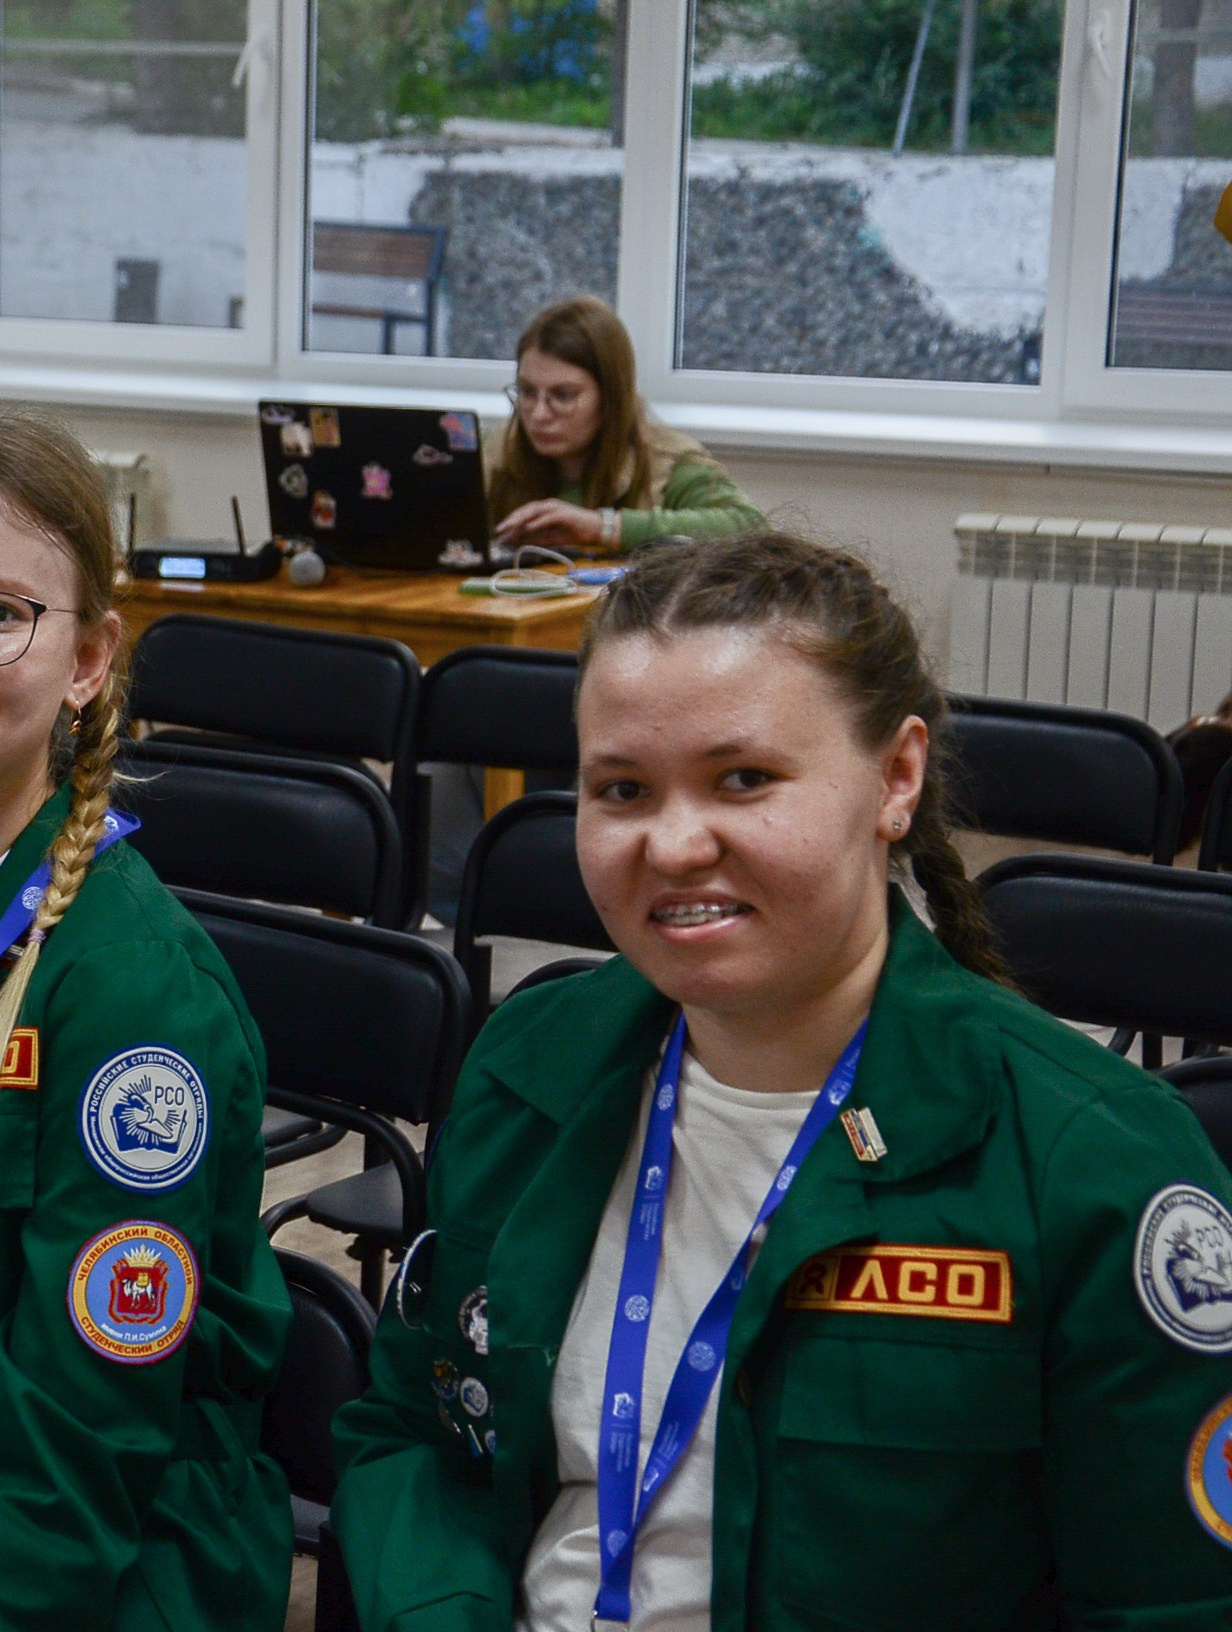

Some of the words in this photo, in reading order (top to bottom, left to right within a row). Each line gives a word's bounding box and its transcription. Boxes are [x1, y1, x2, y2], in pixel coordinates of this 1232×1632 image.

[89, 1060, 129, 1113] РОССИЙСКИЕ
[131, 1053, 191, 1080] СТУДЕНЧЕСКИЕ
[154, 1085, 185, 1106] РСО
[78, 1226, 148, 1281] ЧЕЛЯБИНСКИЙ
[154, 1230, 193, 1285] ОБЛАСТНОЙ
[850, 1259, 985, 1306] ЛСО
[156, 1320, 185, 1348] ОТРЯД
